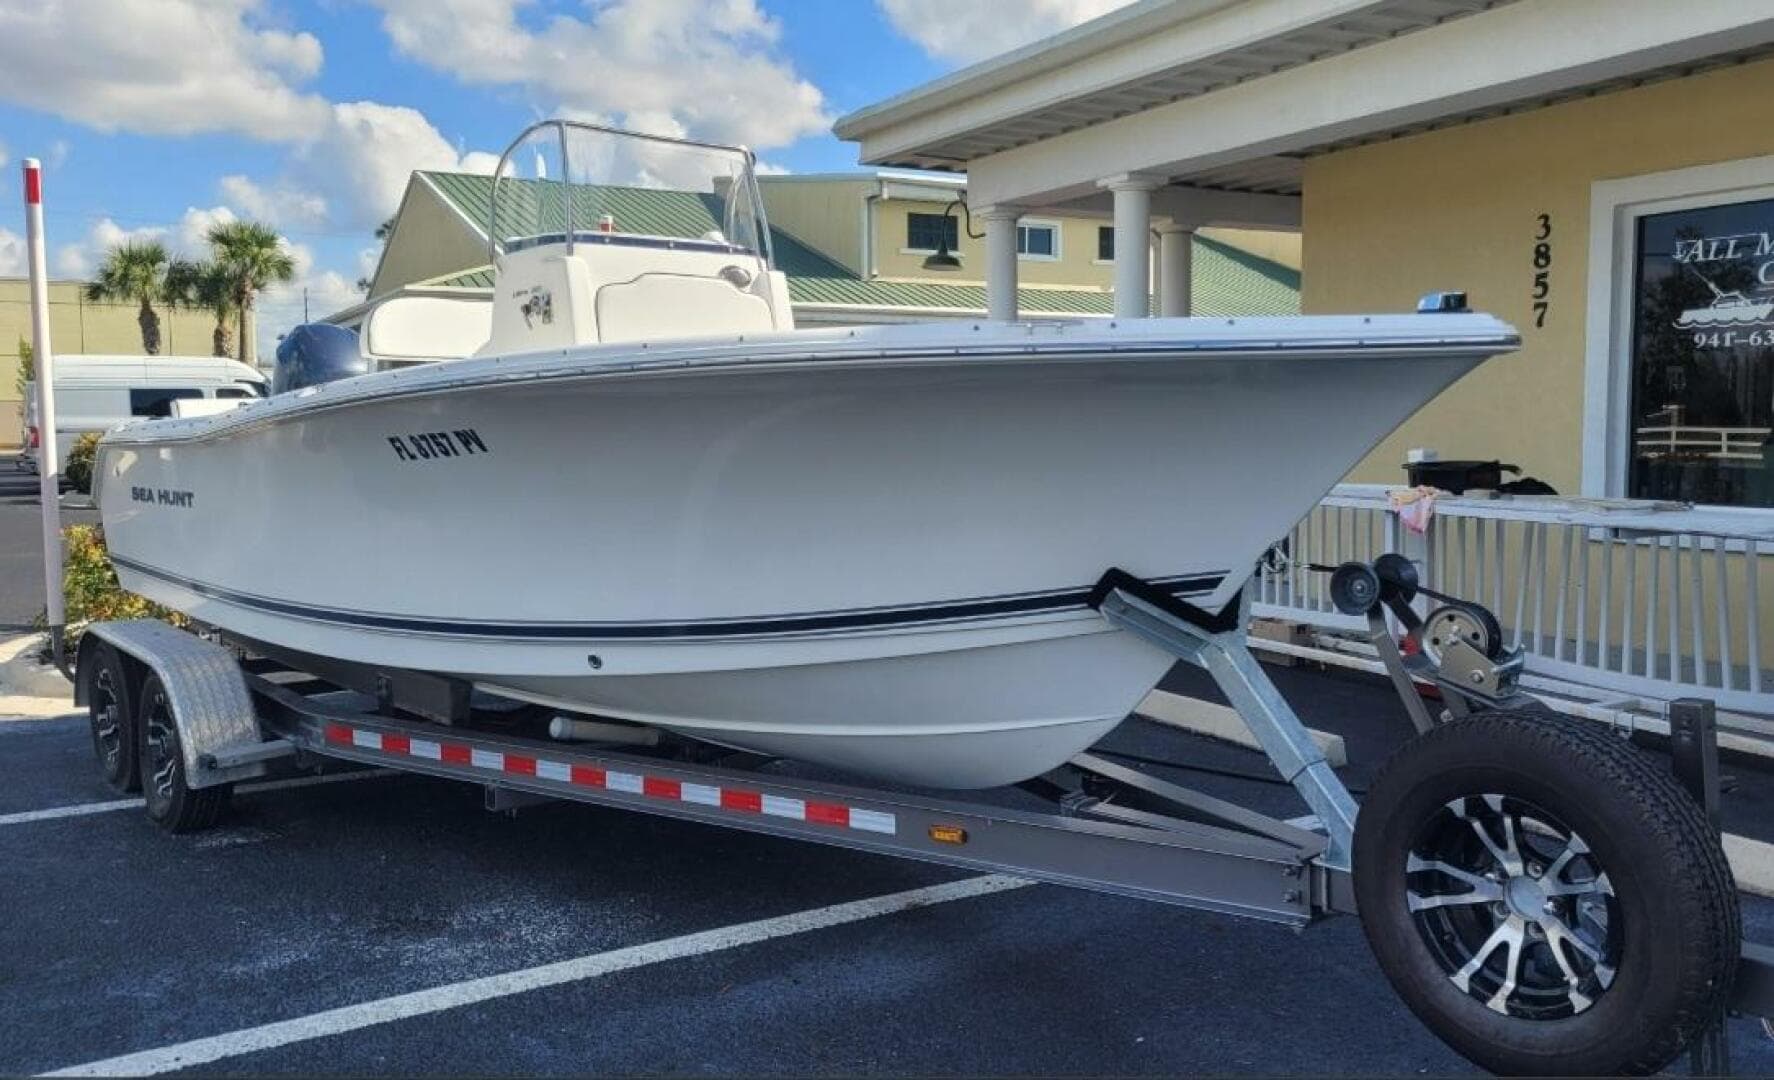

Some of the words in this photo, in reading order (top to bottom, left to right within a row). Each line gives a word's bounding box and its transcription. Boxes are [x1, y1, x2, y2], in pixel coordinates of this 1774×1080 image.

[1532, 213, 1551, 328] 3857
[132, 486, 155, 503] SEA
[158, 489, 194, 508] HUNT
